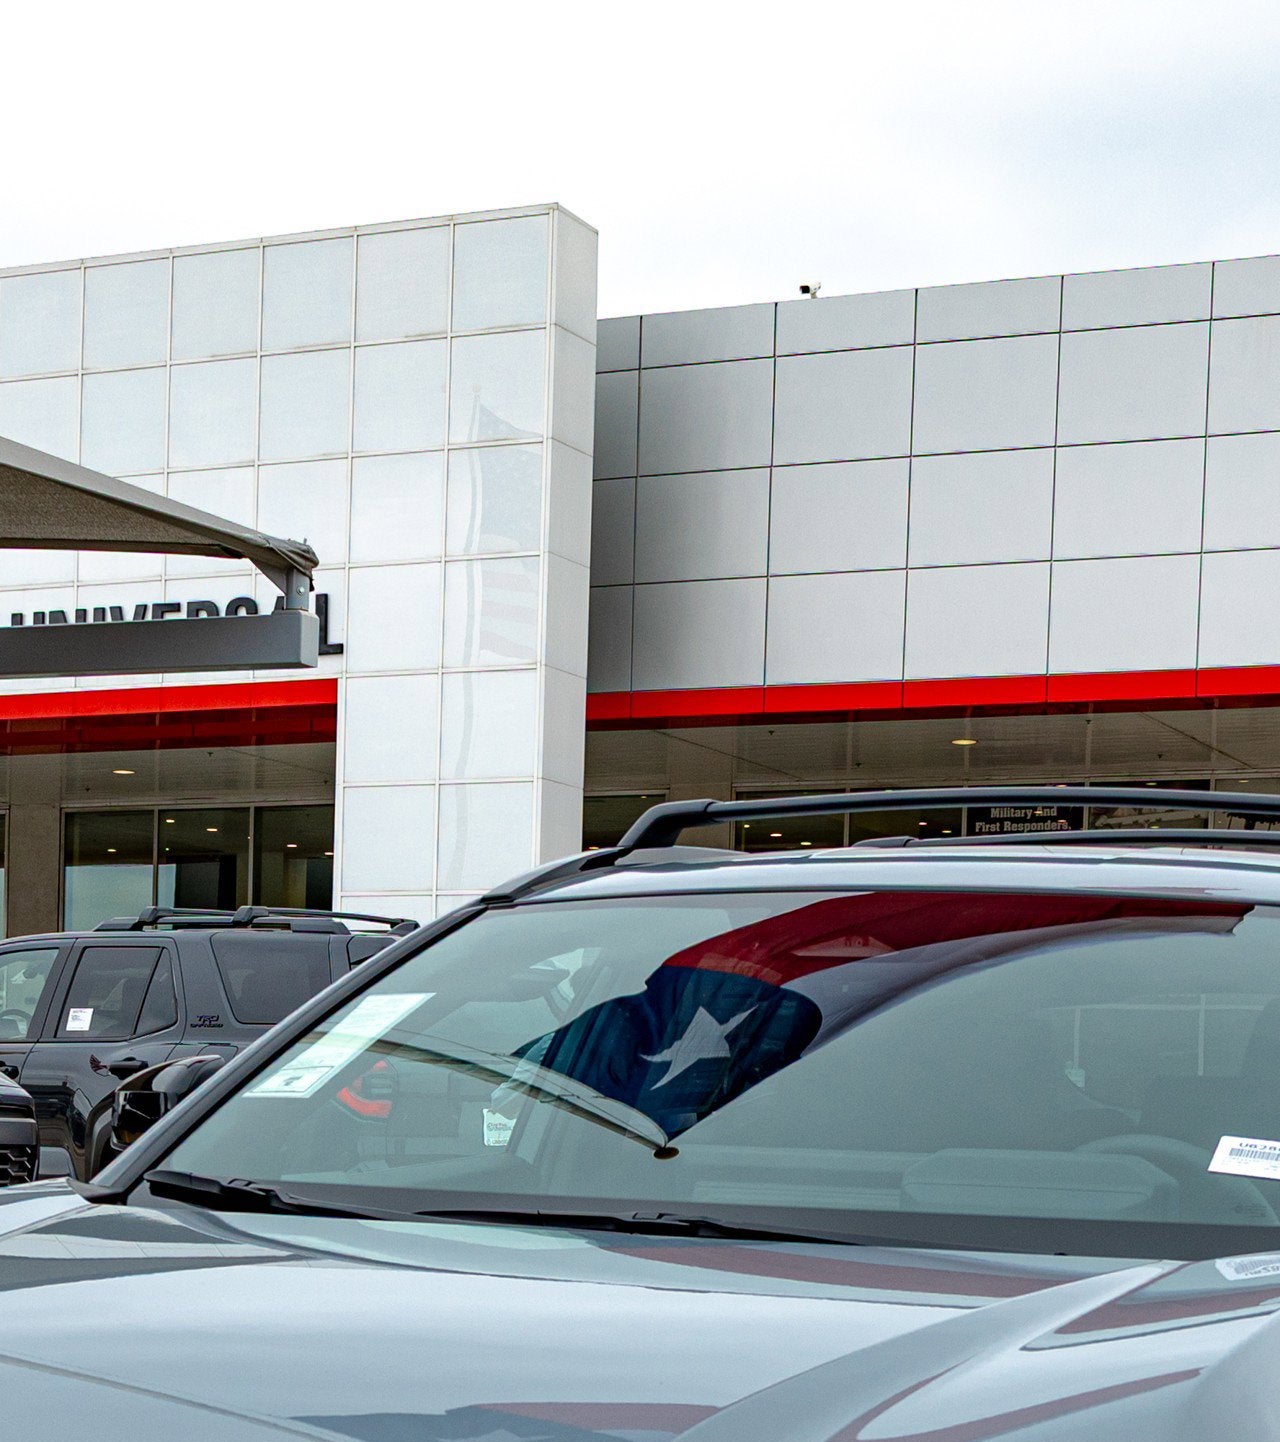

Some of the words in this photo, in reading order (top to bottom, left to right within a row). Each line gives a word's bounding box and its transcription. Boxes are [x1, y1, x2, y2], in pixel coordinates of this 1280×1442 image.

[990, 807, 1033, 819] Military
[1035, 806, 1057, 817] And
[975, 821, 1001, 833] First
